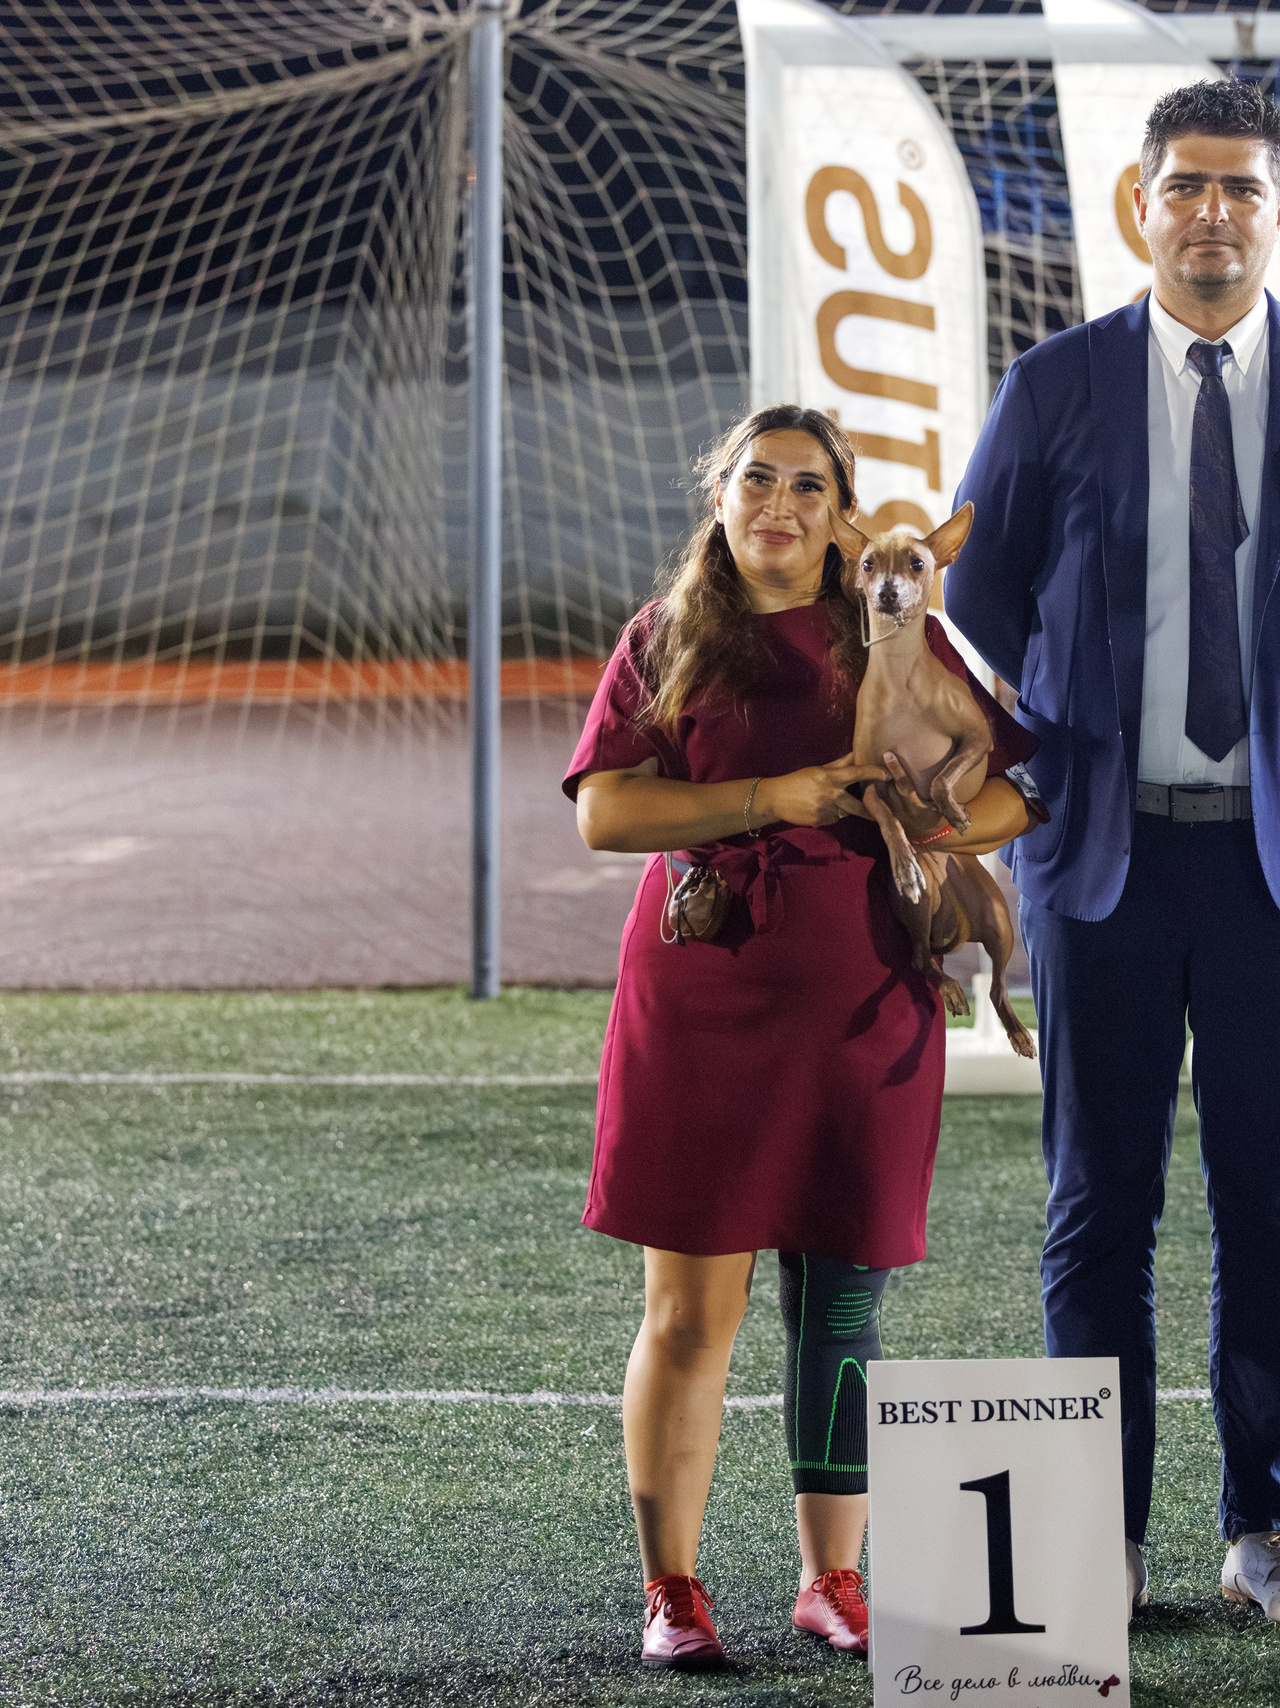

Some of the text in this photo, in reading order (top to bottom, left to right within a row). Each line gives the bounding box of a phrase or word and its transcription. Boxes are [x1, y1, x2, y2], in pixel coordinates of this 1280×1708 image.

[878, 1396, 1104, 1425] BEST DINNER
[960, 1469, 1046, 1636] 1
[894, 1664, 945, 1695] Все
[951, 1676, 1002, 1701] дело
[1007, 1666, 1022, 1687] в
